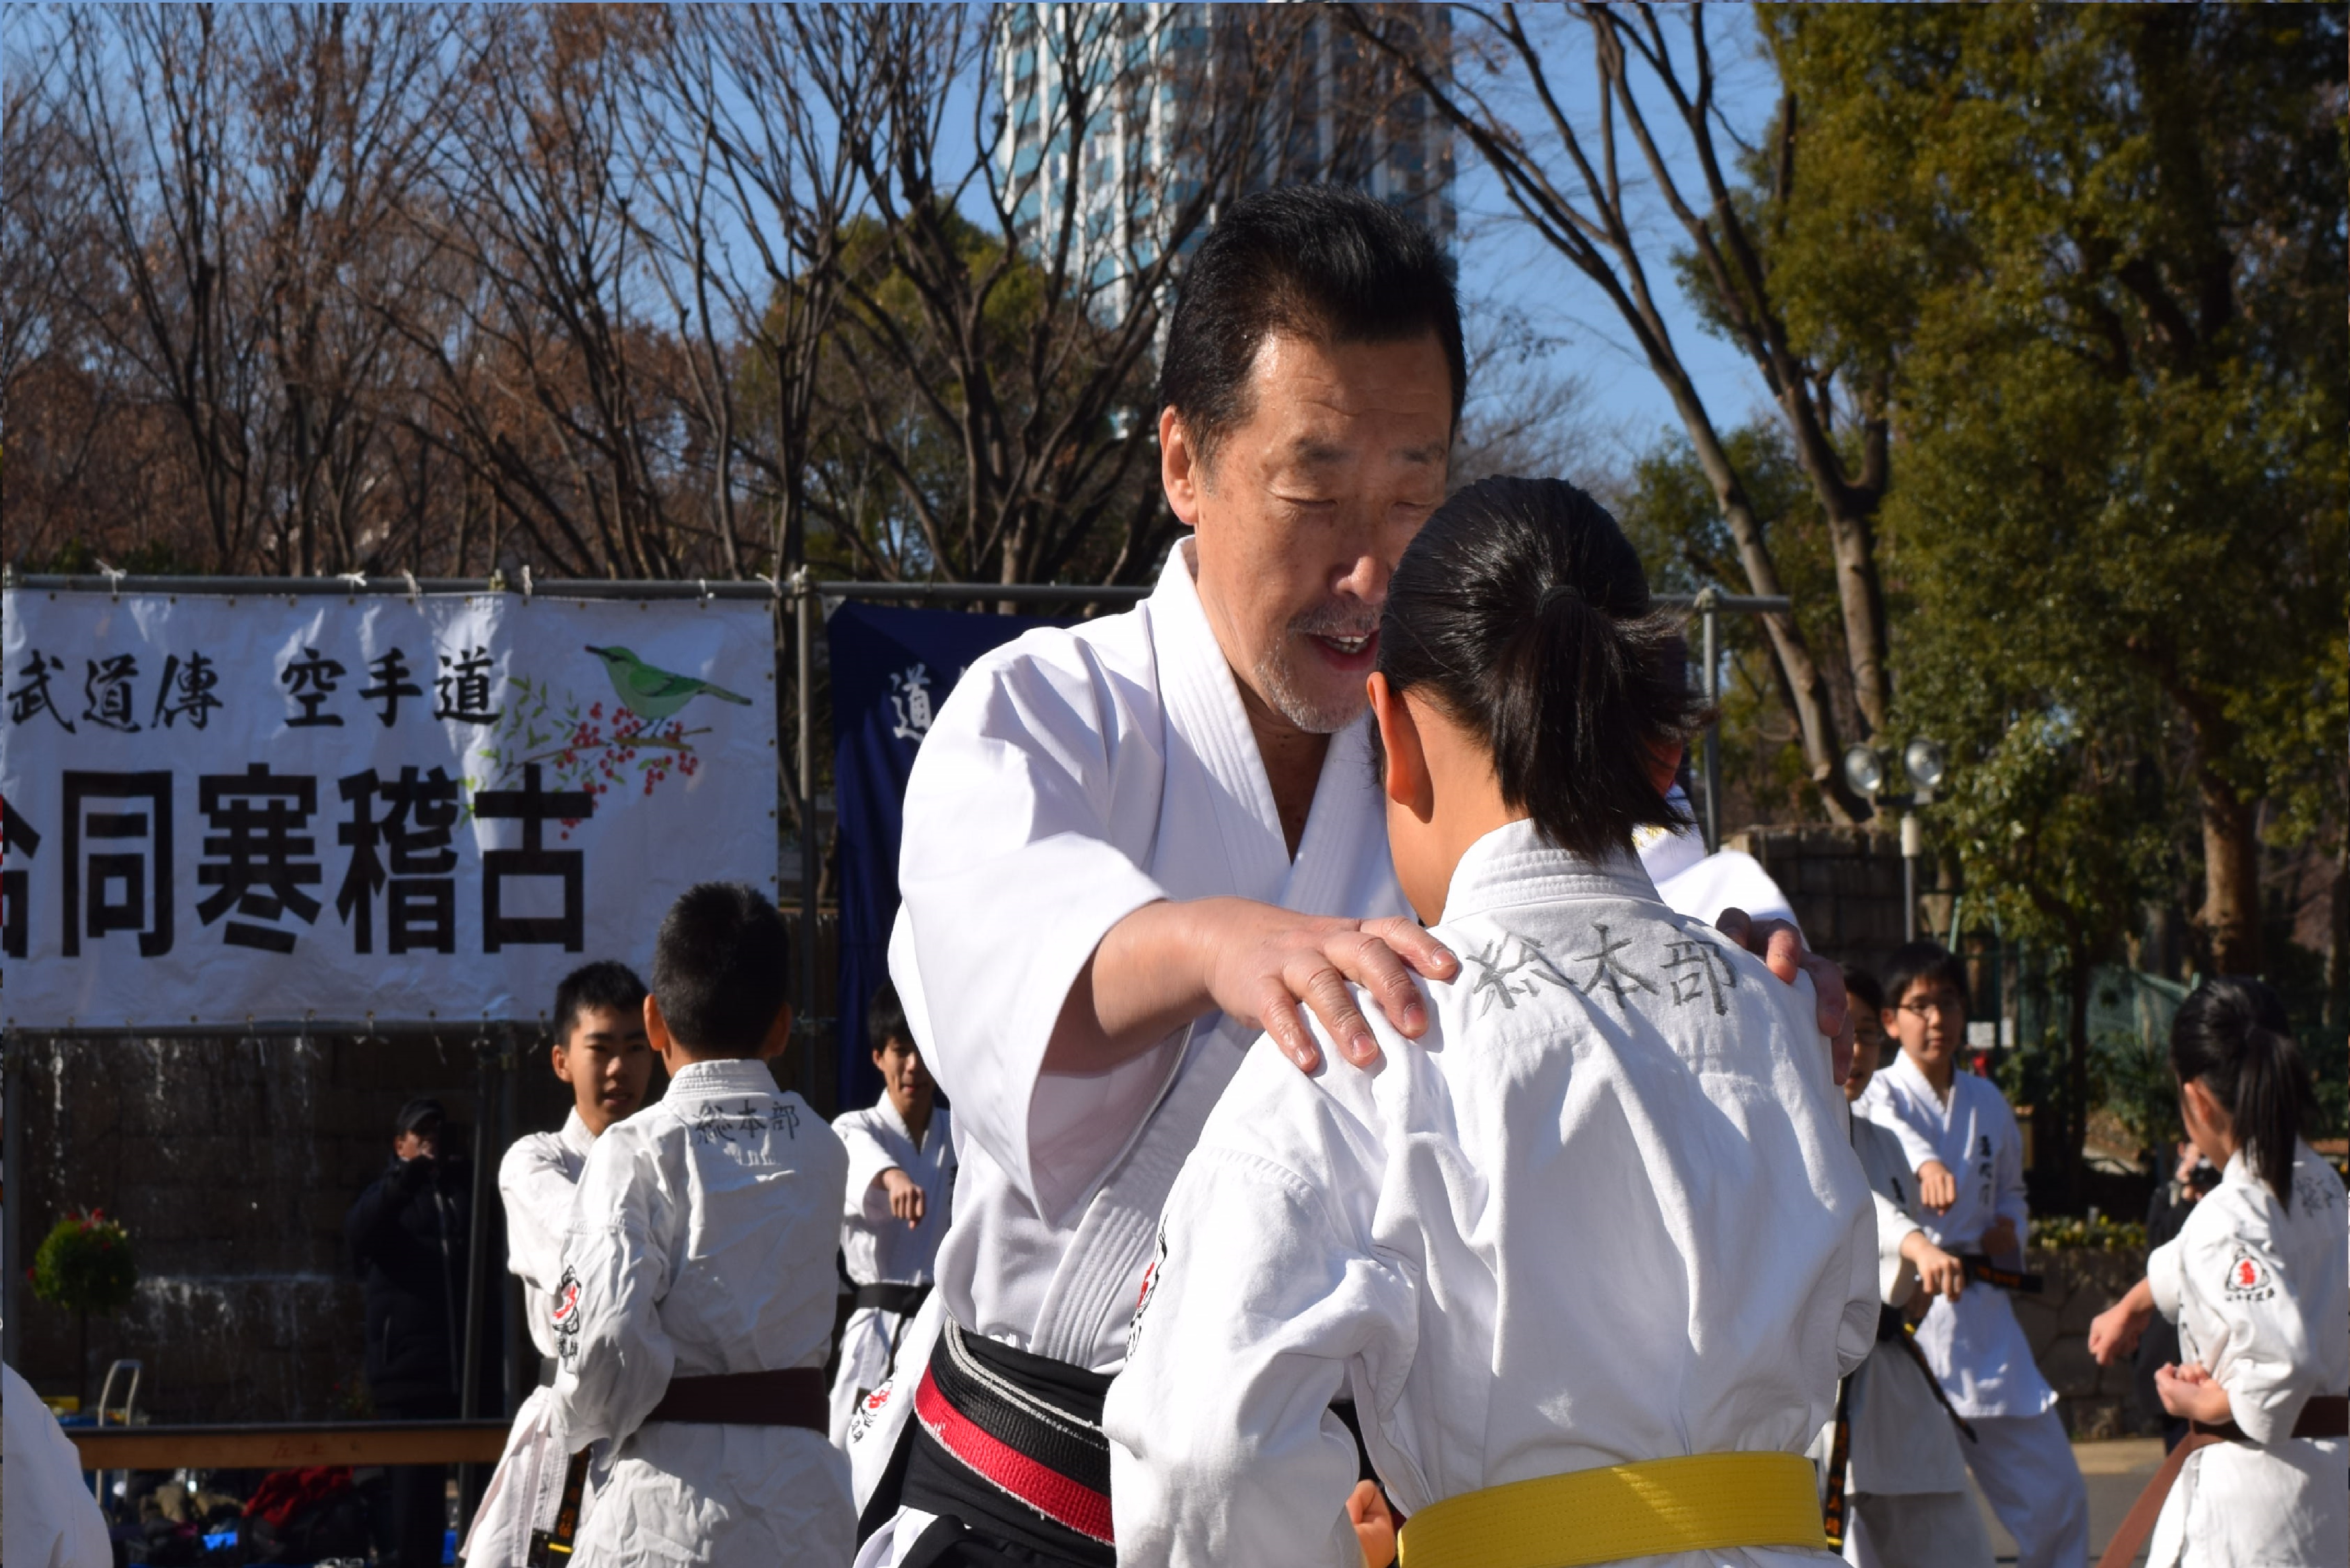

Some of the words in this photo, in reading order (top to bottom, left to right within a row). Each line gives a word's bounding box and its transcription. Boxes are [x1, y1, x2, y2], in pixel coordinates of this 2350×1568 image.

[281, 646, 502, 728] 空手道
[890, 662, 965, 743] 道
